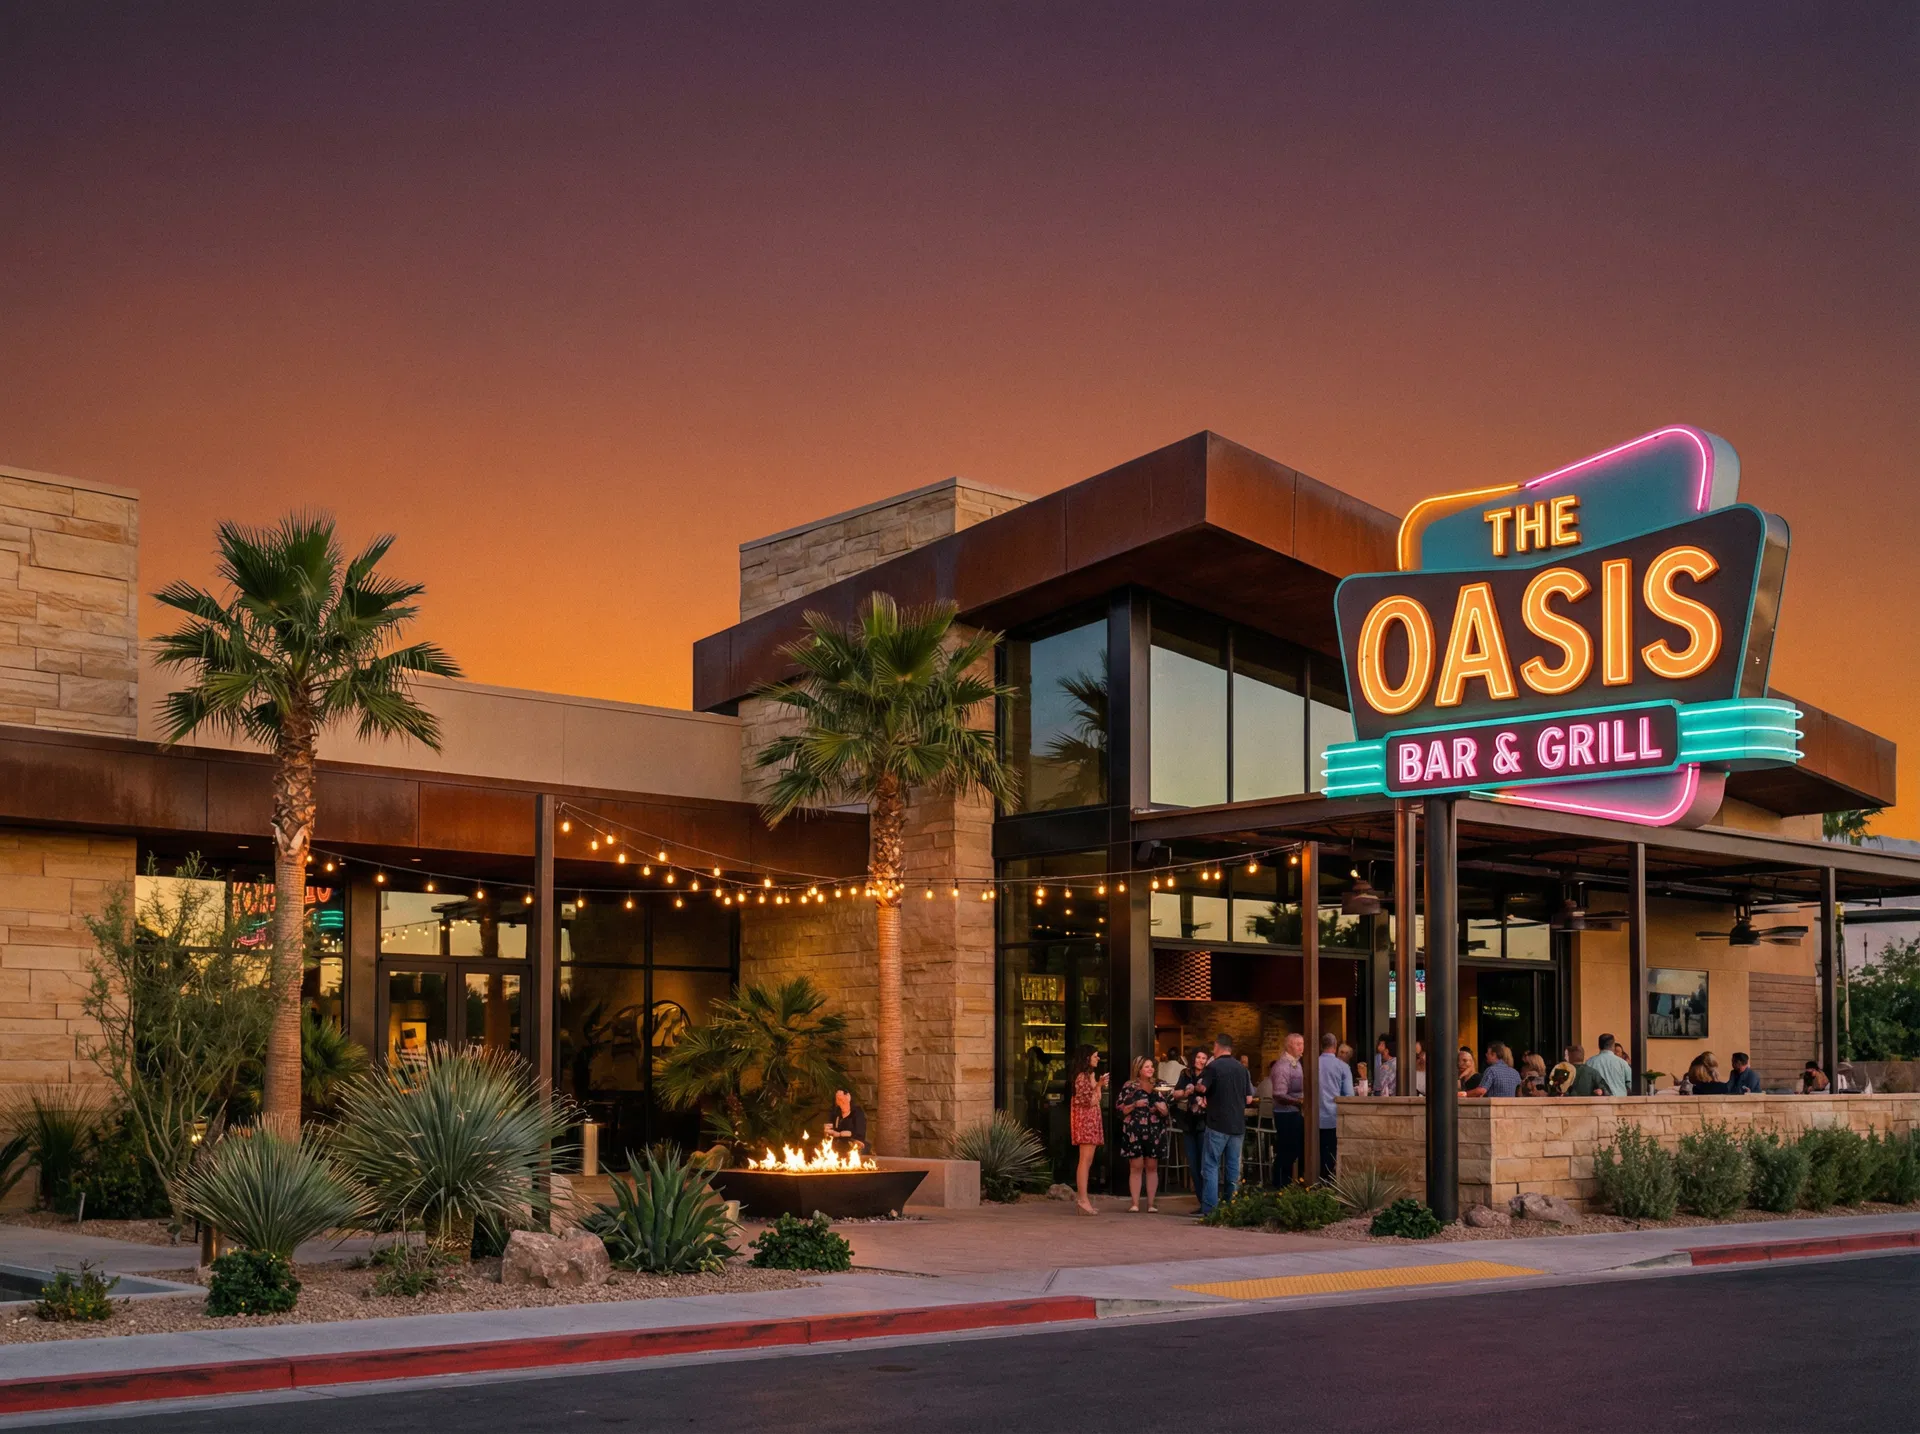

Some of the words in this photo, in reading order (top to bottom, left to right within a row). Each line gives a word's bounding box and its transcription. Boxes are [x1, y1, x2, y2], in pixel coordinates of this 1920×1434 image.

[1484, 495, 1581, 556] THE
[1358, 546, 1721, 714] OASIS
[1399, 738, 1478, 783] BAR
[1492, 732, 1522, 775] &
[1537, 717, 1662, 769] GRILL
